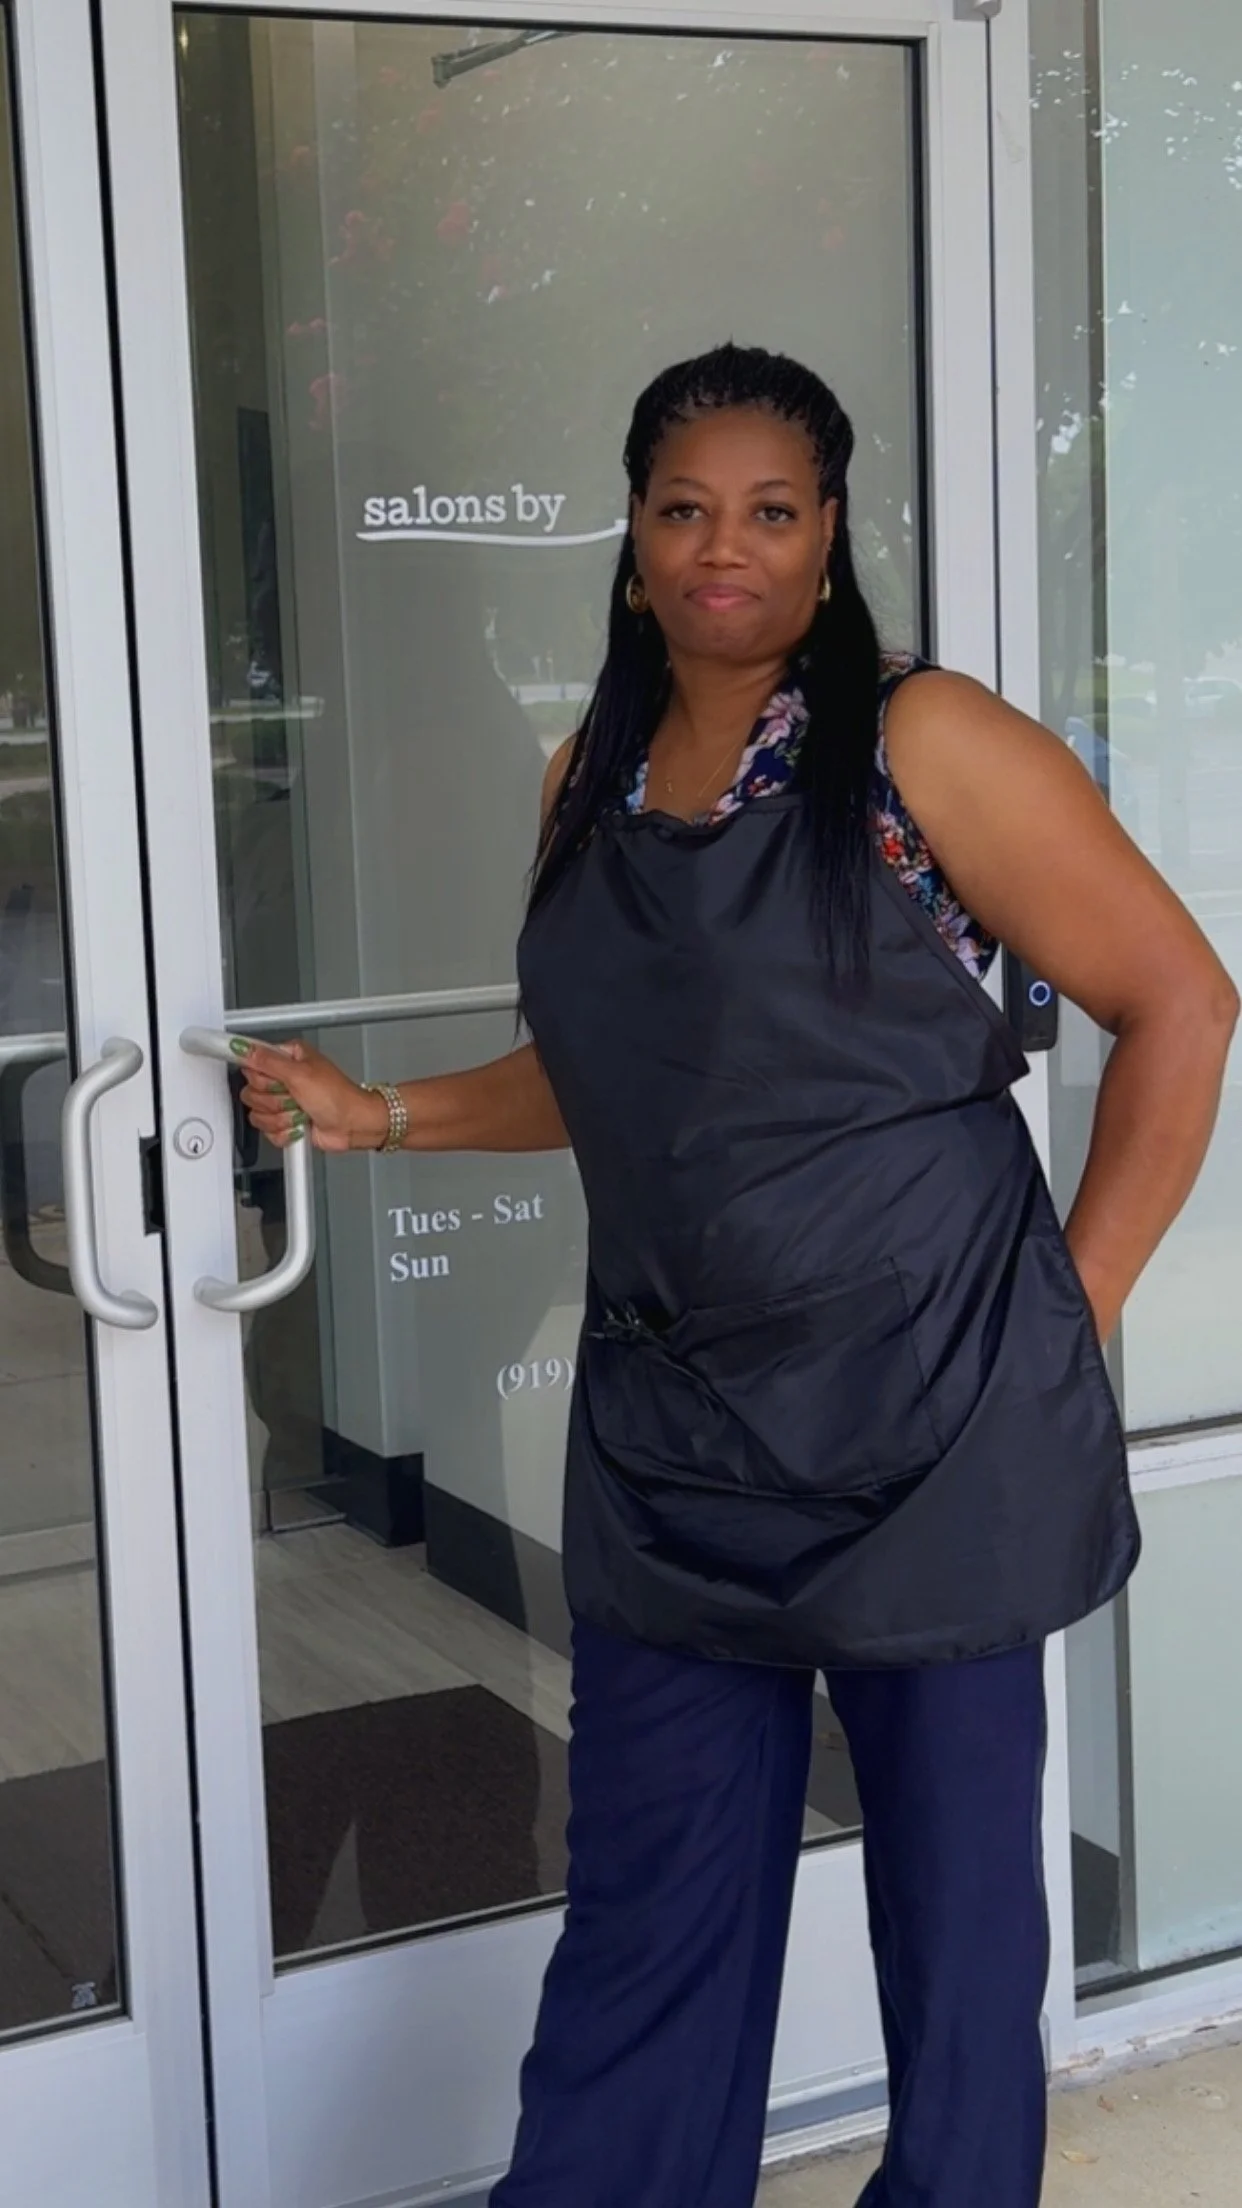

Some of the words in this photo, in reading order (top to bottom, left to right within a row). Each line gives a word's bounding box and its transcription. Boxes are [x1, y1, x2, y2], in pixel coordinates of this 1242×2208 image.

[363, 484, 506, 526] salons
[511, 483, 567, 533] by
[387, 1207, 462, 1238] Tues
[493, 1193, 545, 1225] Sat
[389, 1251, 451, 1283] Sun
[496, 1357, 575, 1400] (919)
